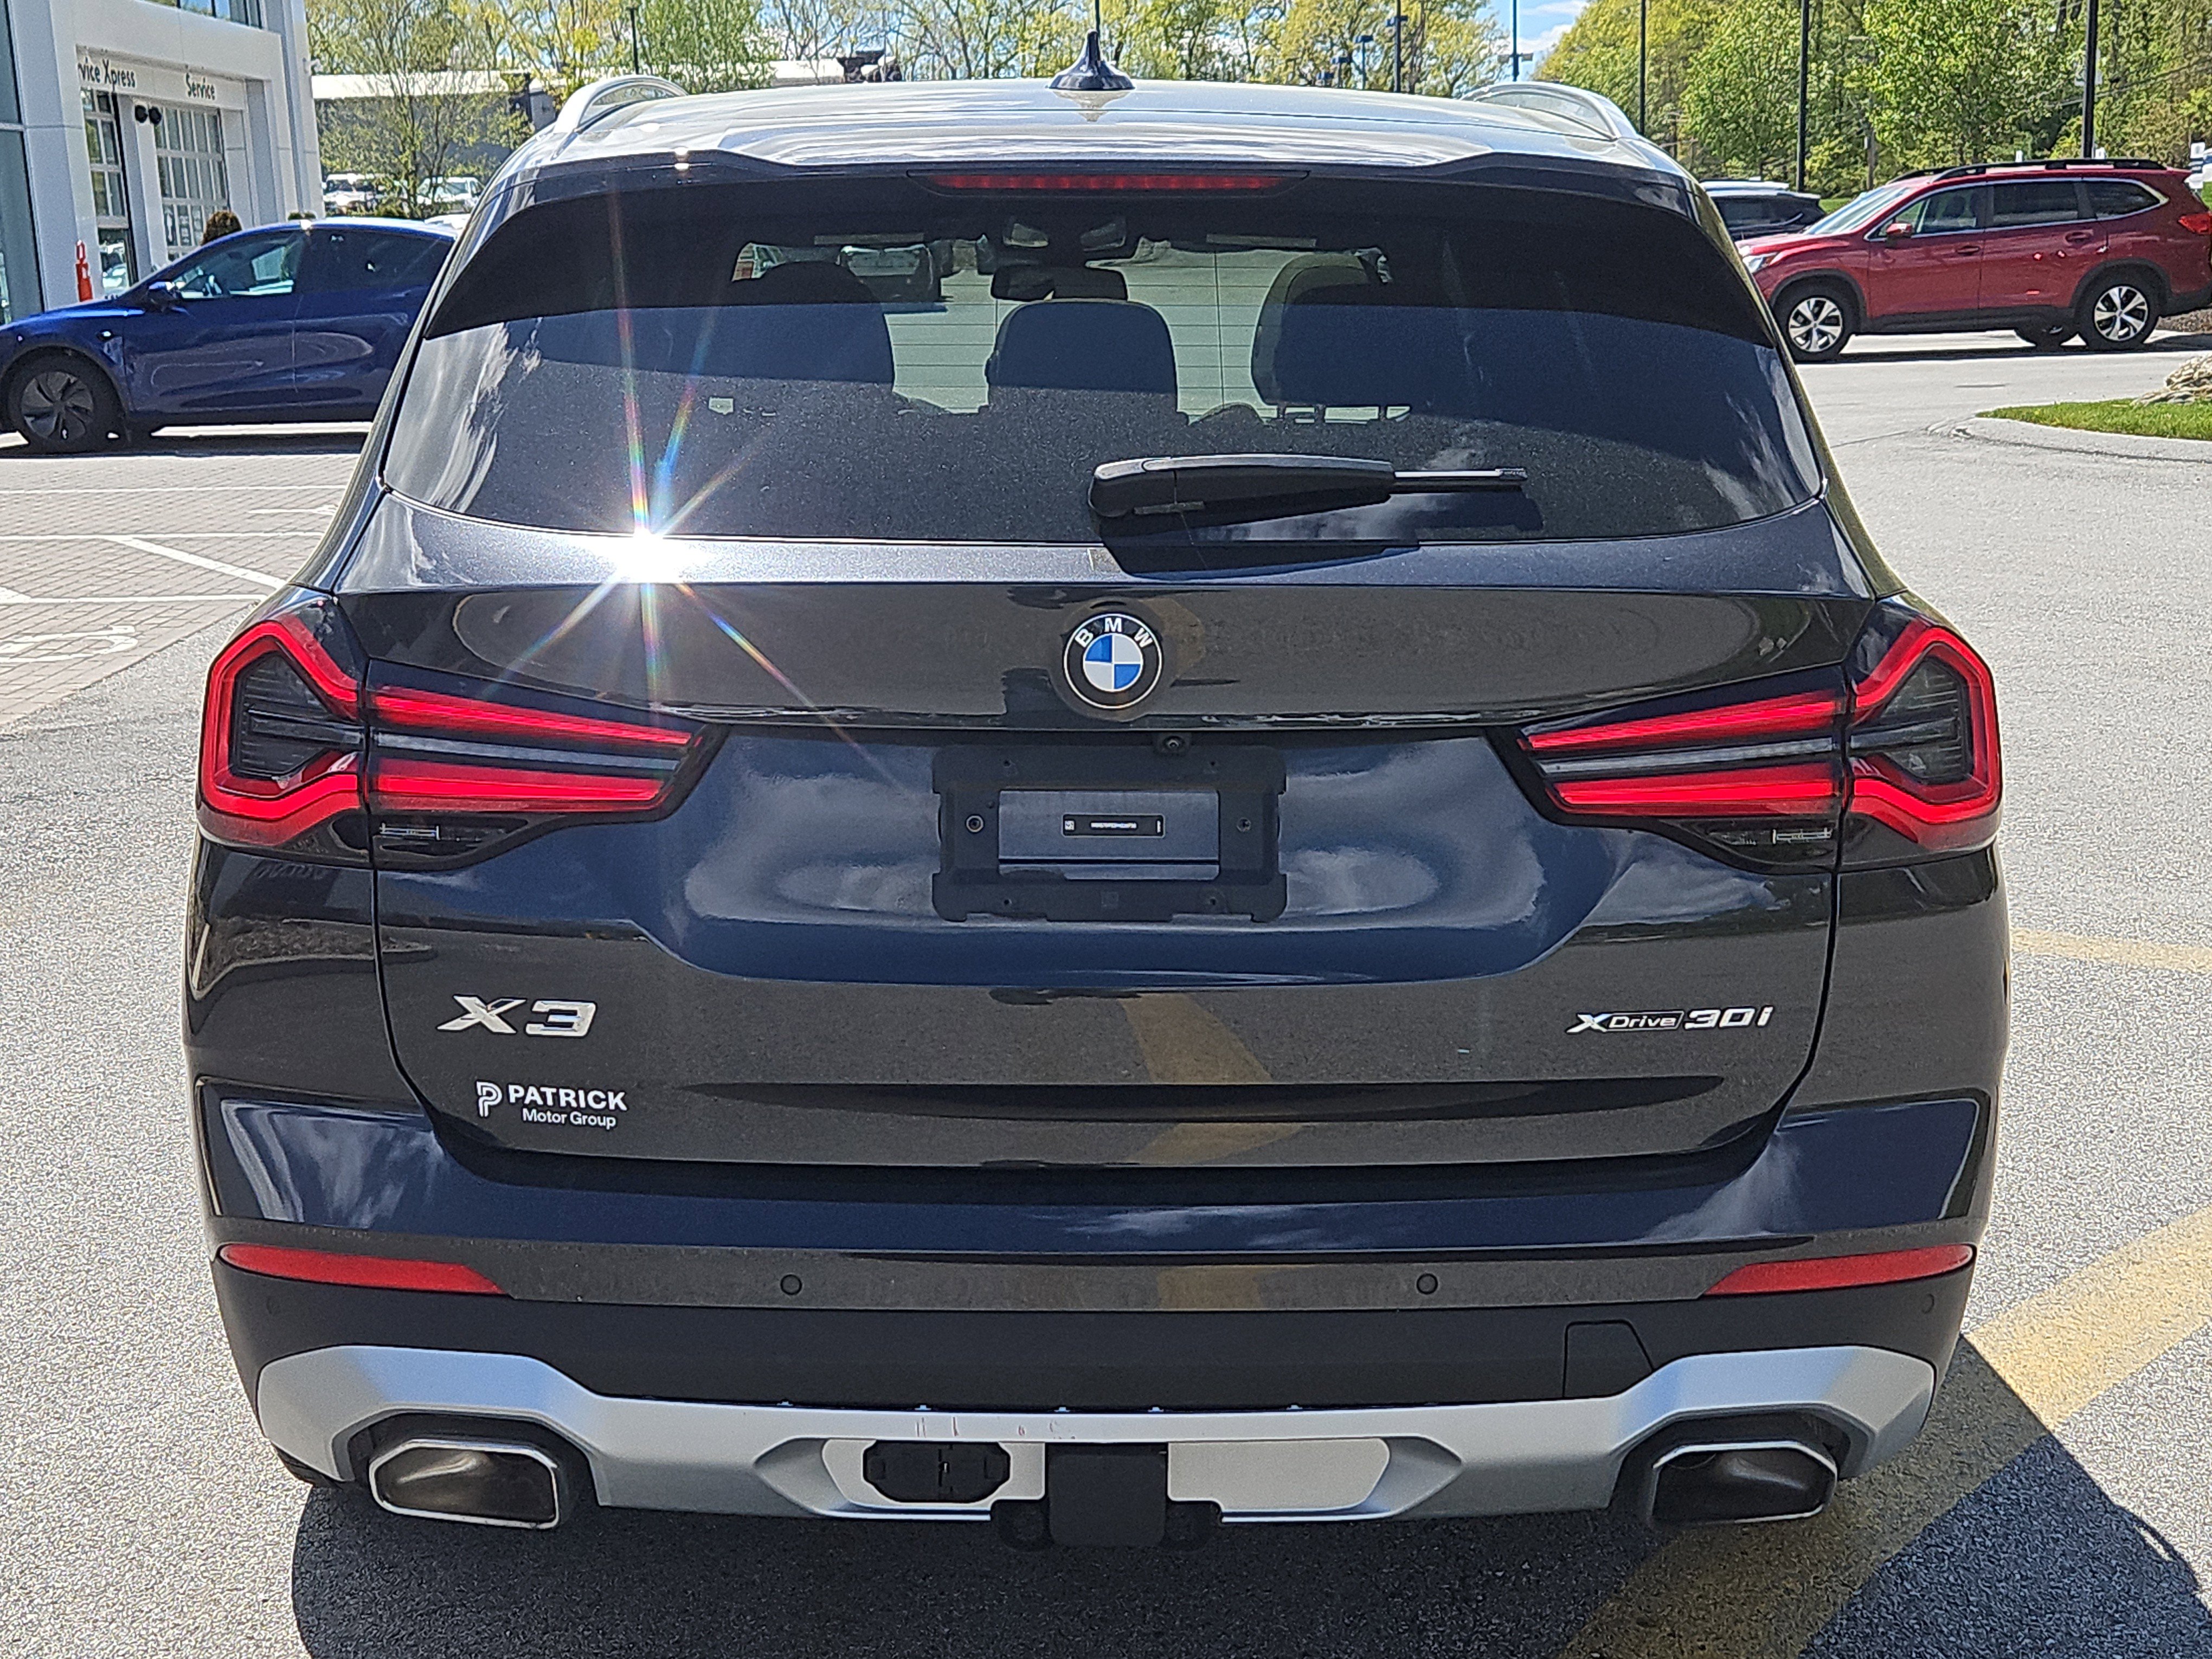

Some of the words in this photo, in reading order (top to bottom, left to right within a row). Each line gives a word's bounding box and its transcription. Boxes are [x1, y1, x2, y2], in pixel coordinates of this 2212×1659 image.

[102, 58, 136, 92] Xpress
[186, 72, 215, 100] Service
[1075, 617, 1154, 648] BMW
[437, 995, 596, 1037] X3
[1684, 1006, 1773, 1030] 30i
[508, 1084, 627, 1111] PATRICK
[522, 1108, 568, 1124] Motor
[570, 1111, 616, 1130] Group
